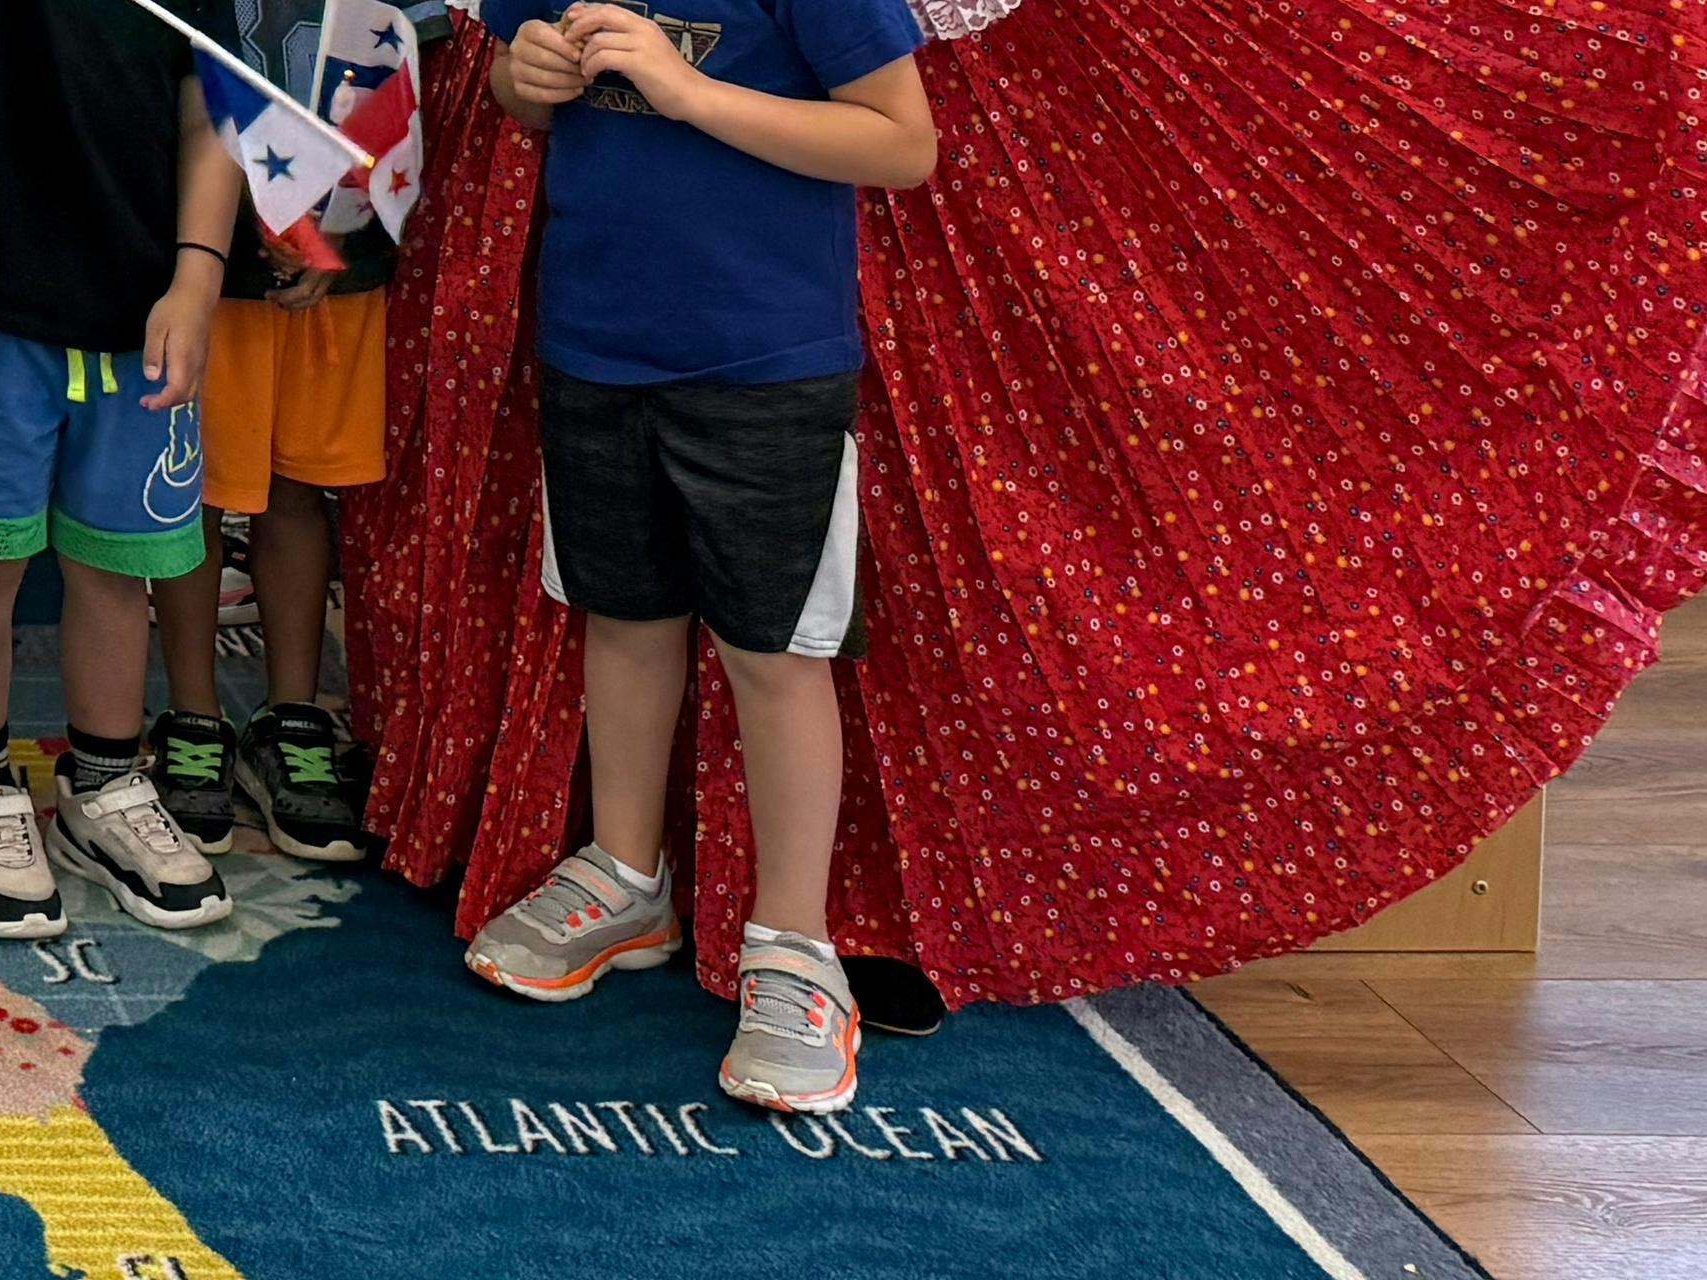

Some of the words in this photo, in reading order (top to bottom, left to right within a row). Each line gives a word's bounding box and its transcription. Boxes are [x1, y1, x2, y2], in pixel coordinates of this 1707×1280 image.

[32, 937, 122, 985] SC
[377, 1099, 739, 1155] ATLANTIC
[767, 1106, 1044, 1163] OCEAN
